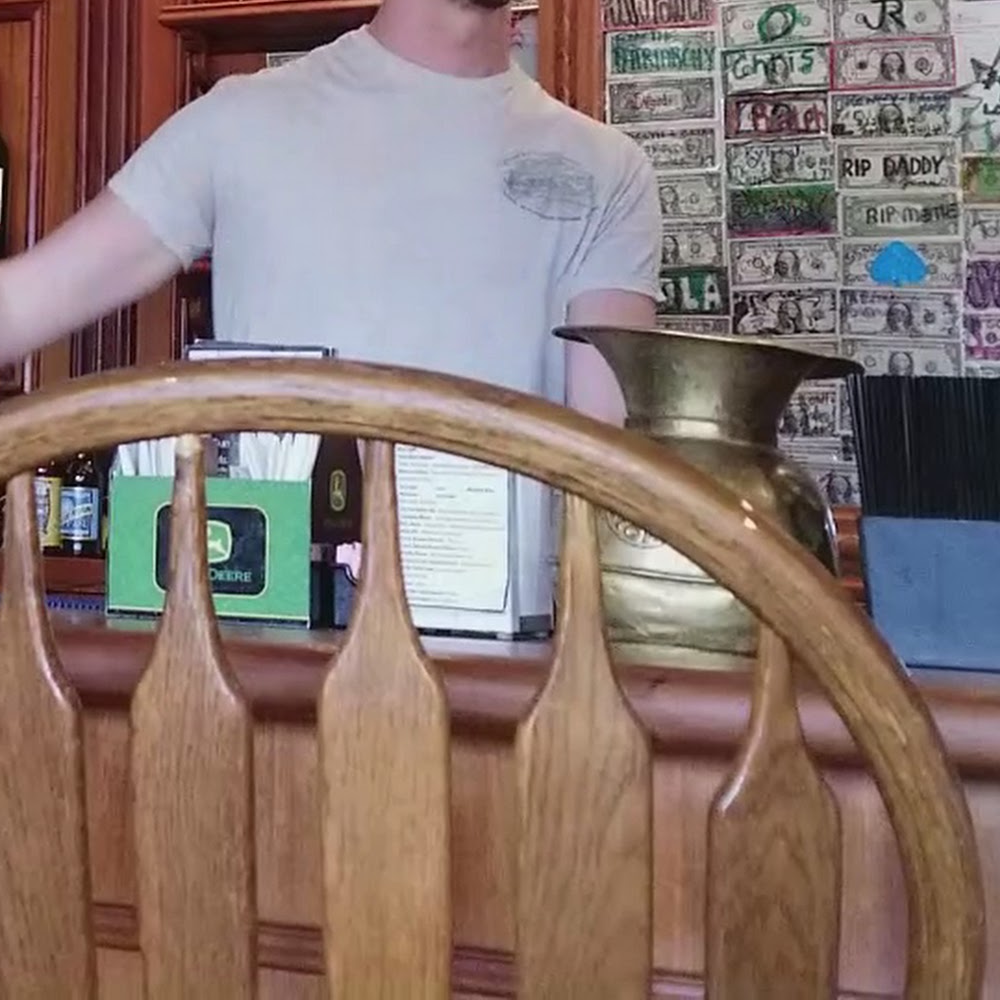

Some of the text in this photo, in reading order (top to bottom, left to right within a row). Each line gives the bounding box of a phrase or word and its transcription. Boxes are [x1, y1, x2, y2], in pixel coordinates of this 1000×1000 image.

[843, 154, 945, 177] RIP DADDY
[866, 205, 896, 224] RIP
[210, 571, 252, 582] DEERE
